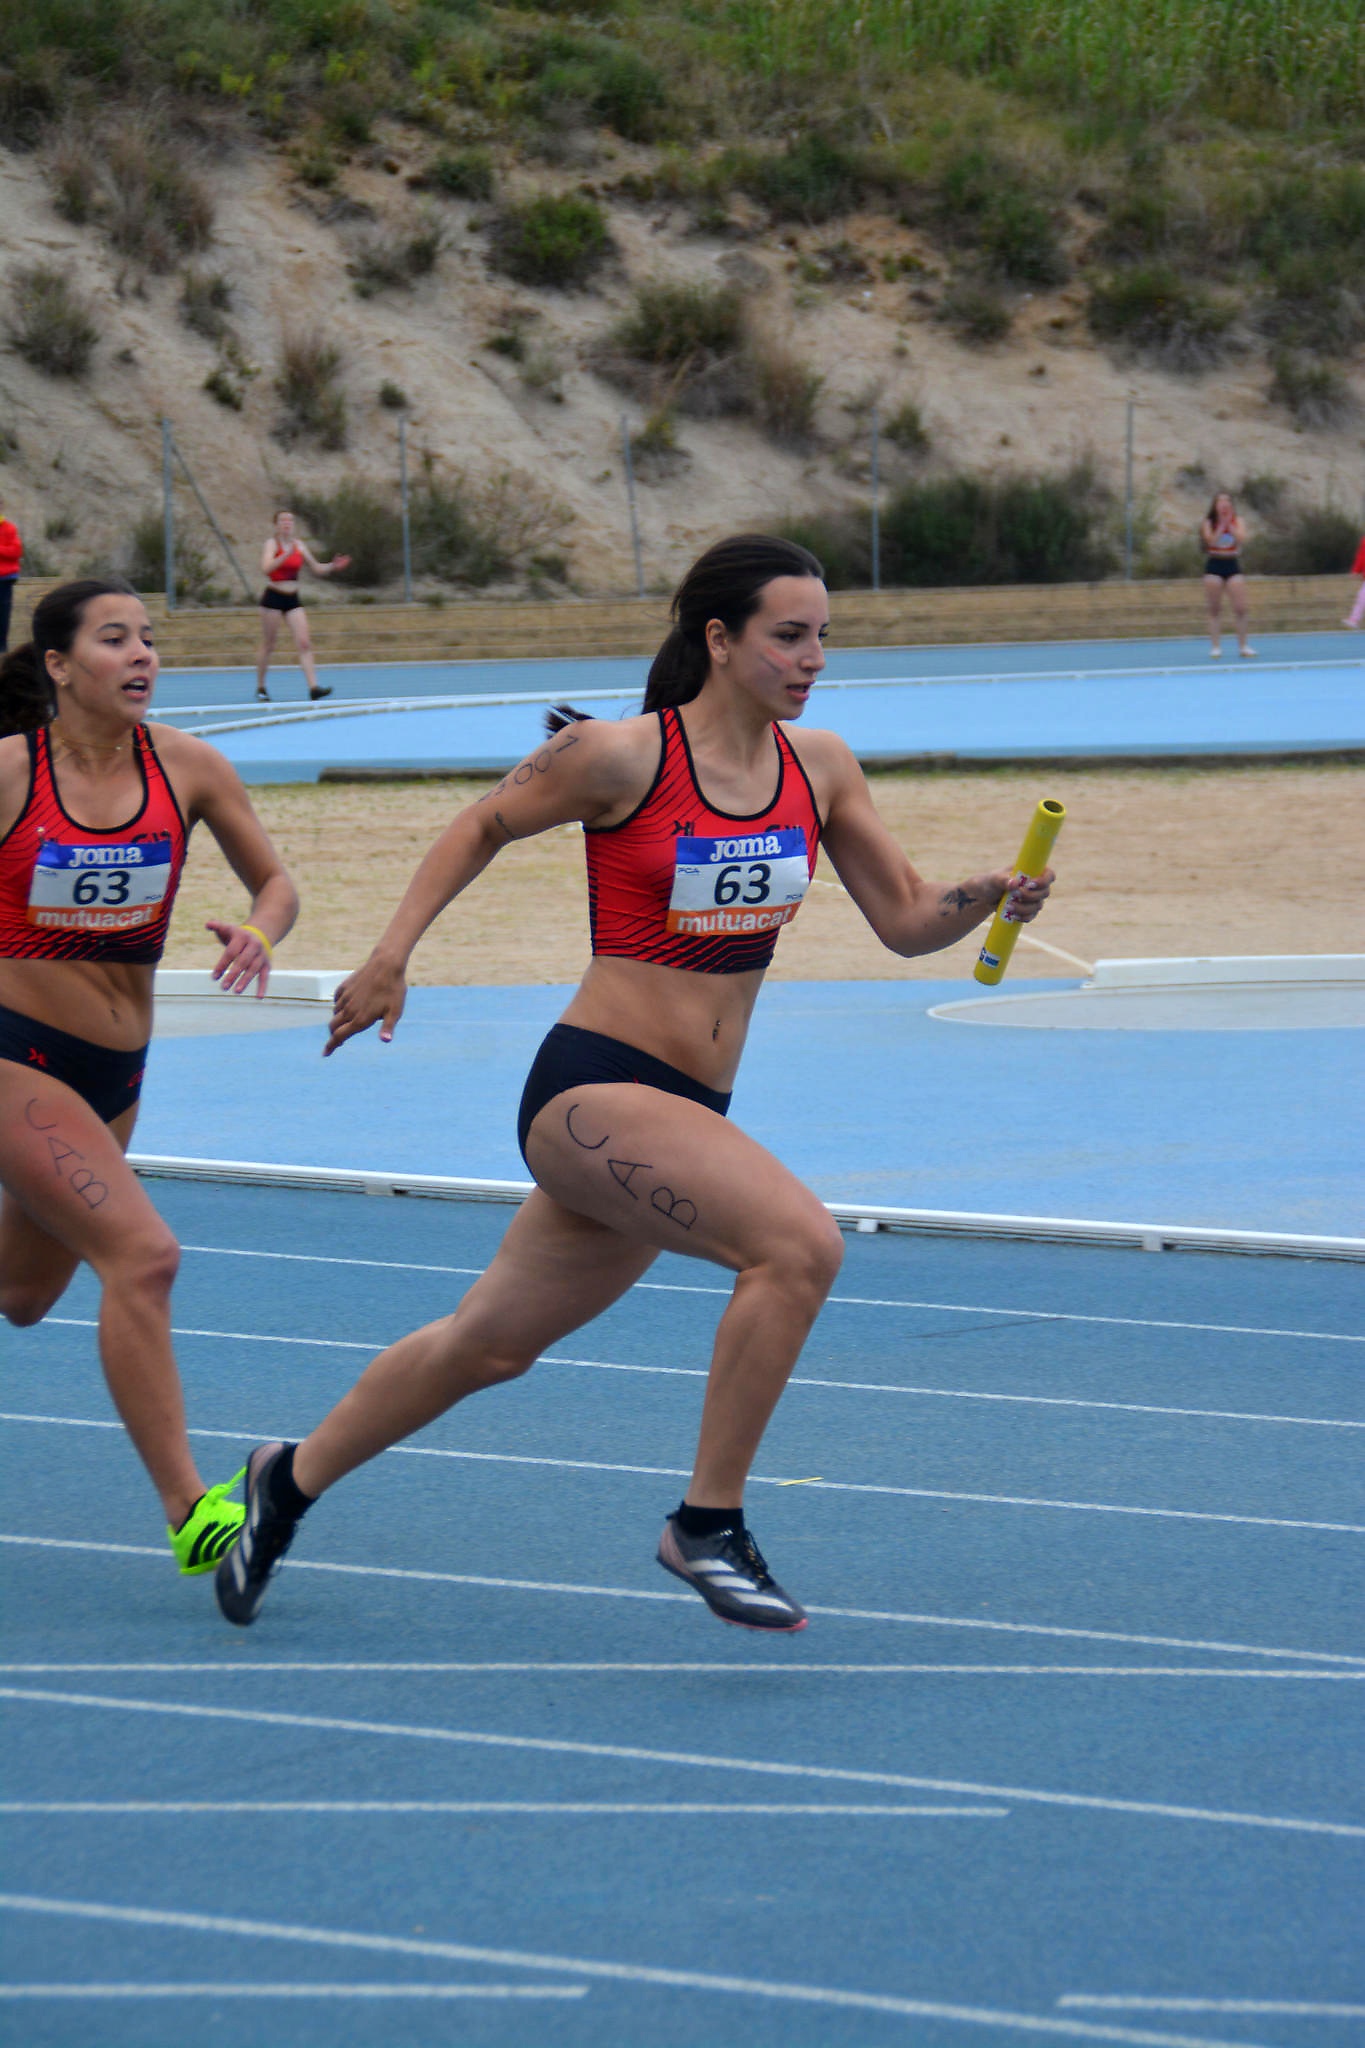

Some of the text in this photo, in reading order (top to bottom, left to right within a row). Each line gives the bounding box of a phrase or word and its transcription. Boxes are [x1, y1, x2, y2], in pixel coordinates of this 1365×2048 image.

[72, 870, 131, 905] 63
[713, 863, 772, 906] 63
[35, 907, 153, 928] mutuacat
[677, 906, 792, 933] mutuacat
[24, 1098, 109, 1210] CAB
[566, 1104, 698, 1231] CAB
